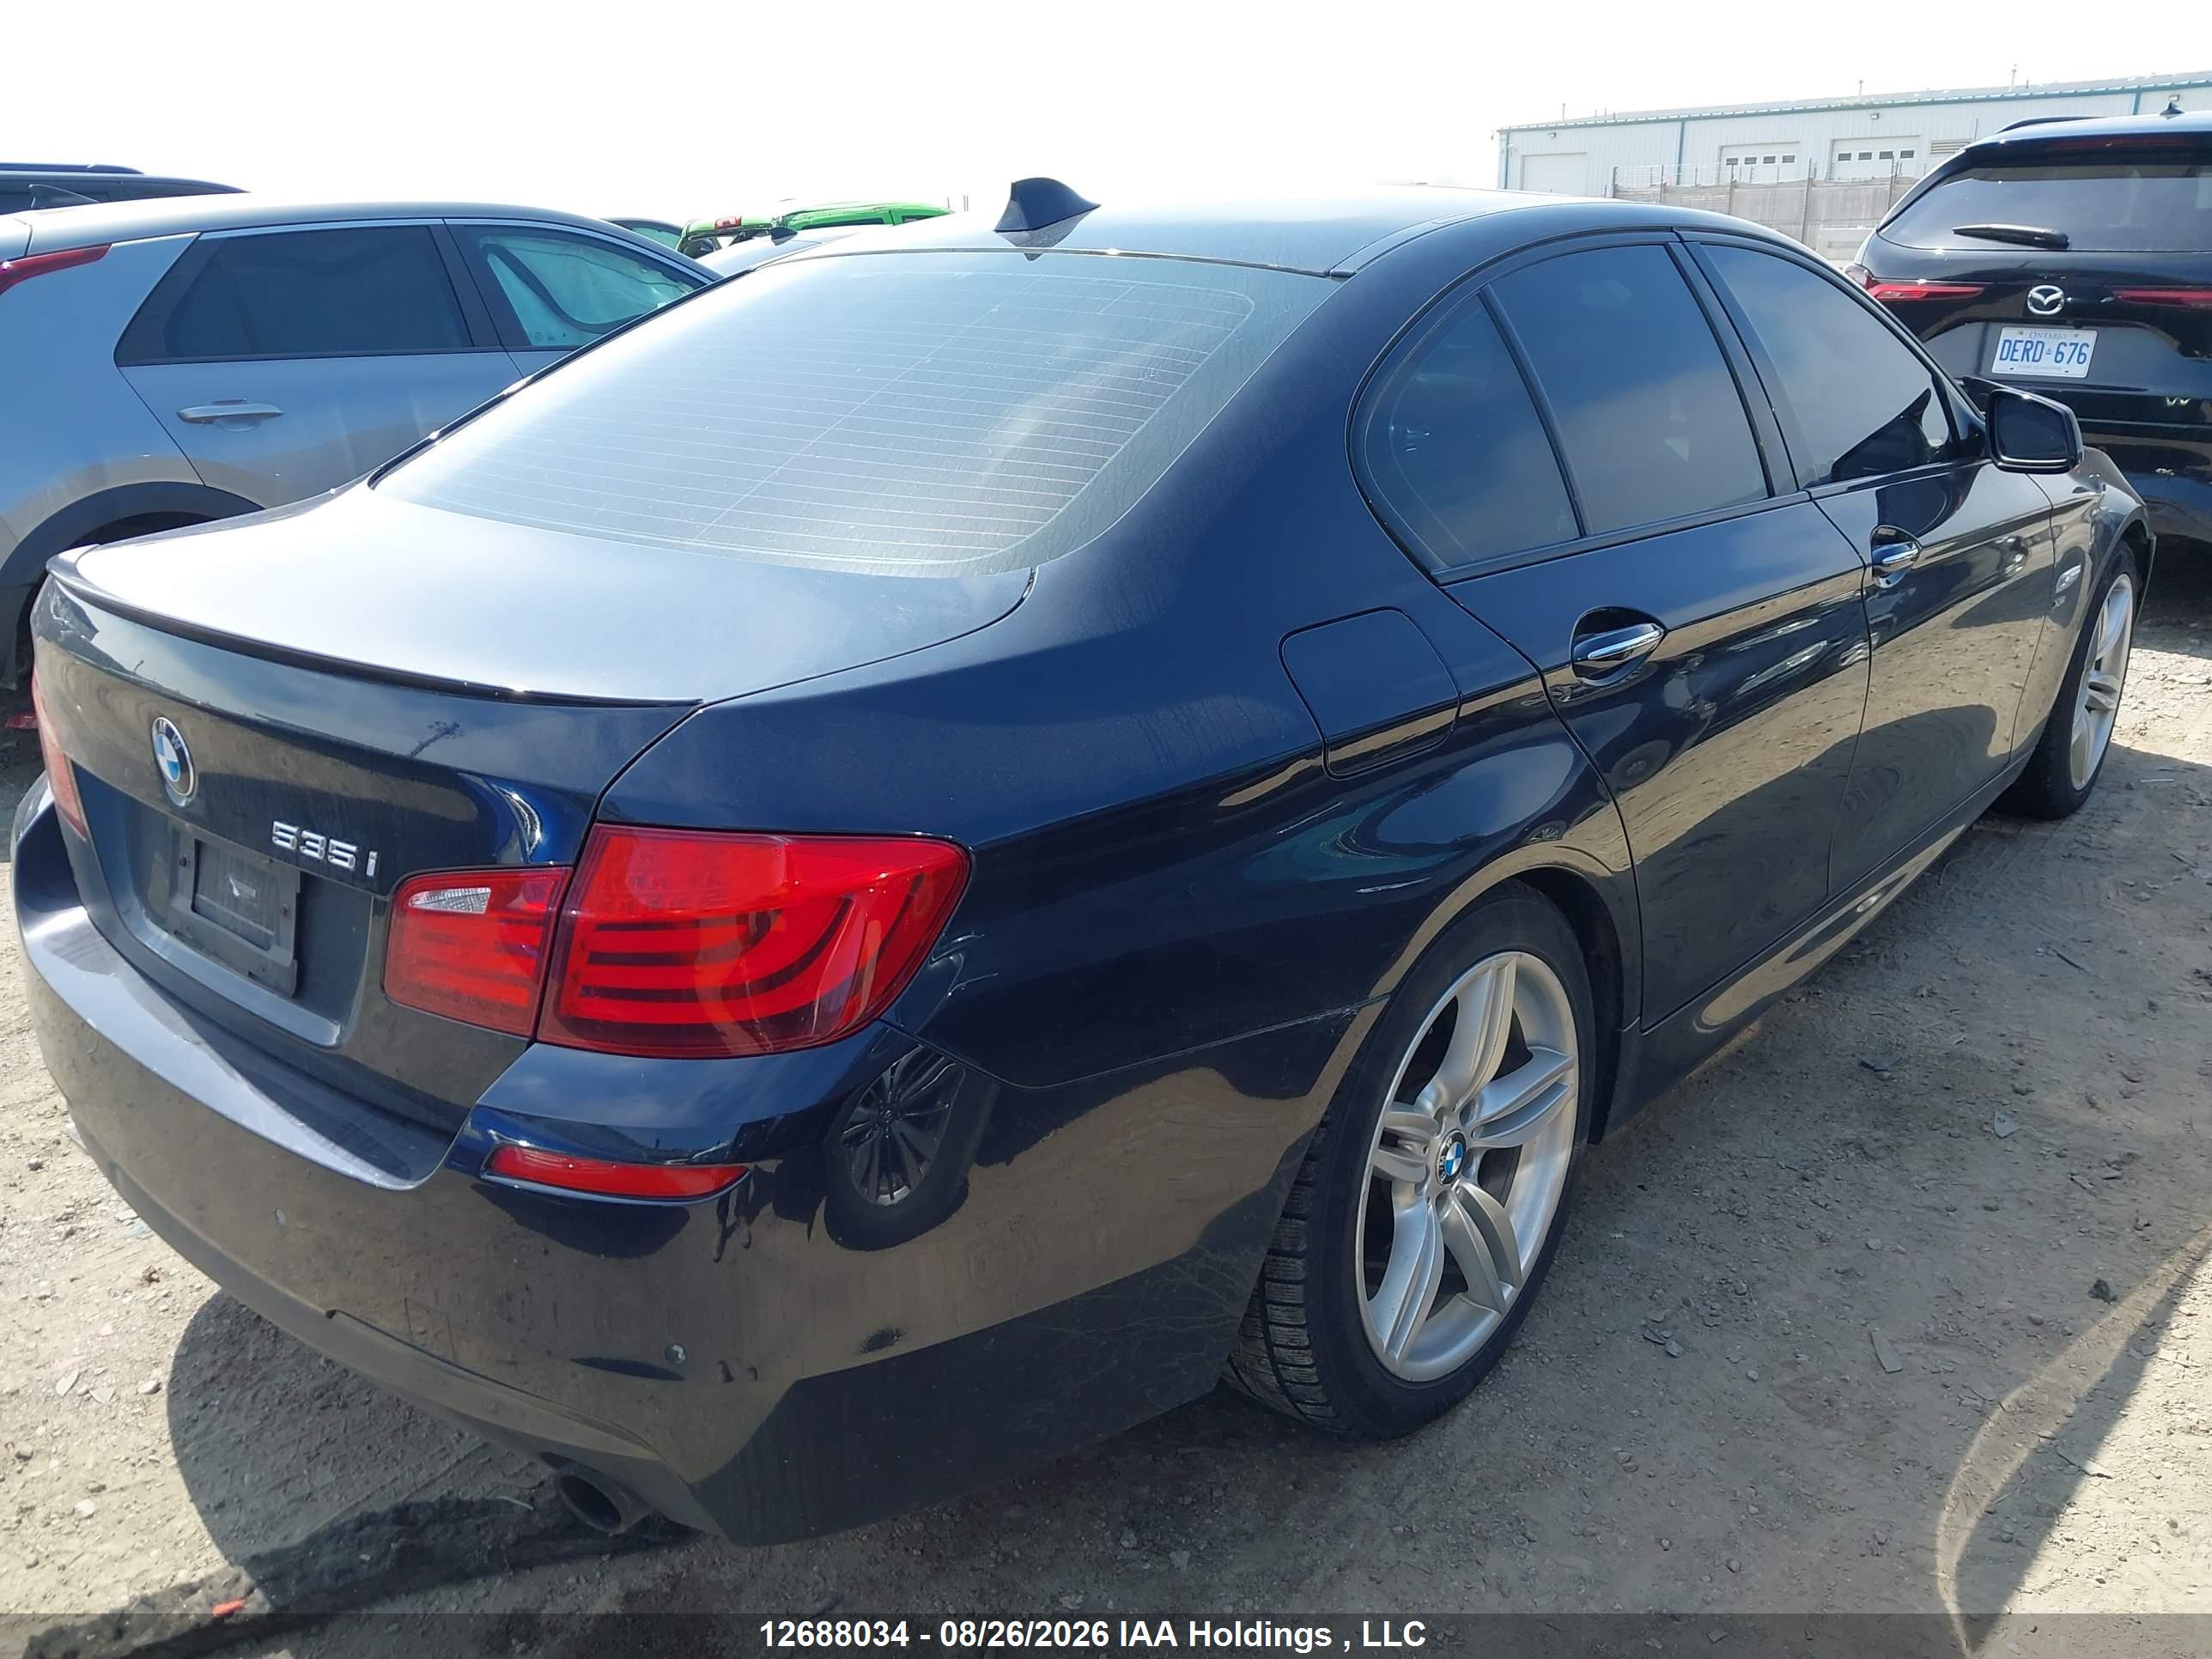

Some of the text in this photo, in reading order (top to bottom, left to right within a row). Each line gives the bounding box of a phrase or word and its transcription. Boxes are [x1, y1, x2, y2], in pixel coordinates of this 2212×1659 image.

[1999, 339, 2089, 365] DERD 676
[1437, 1136, 1453, 1182] BMW
